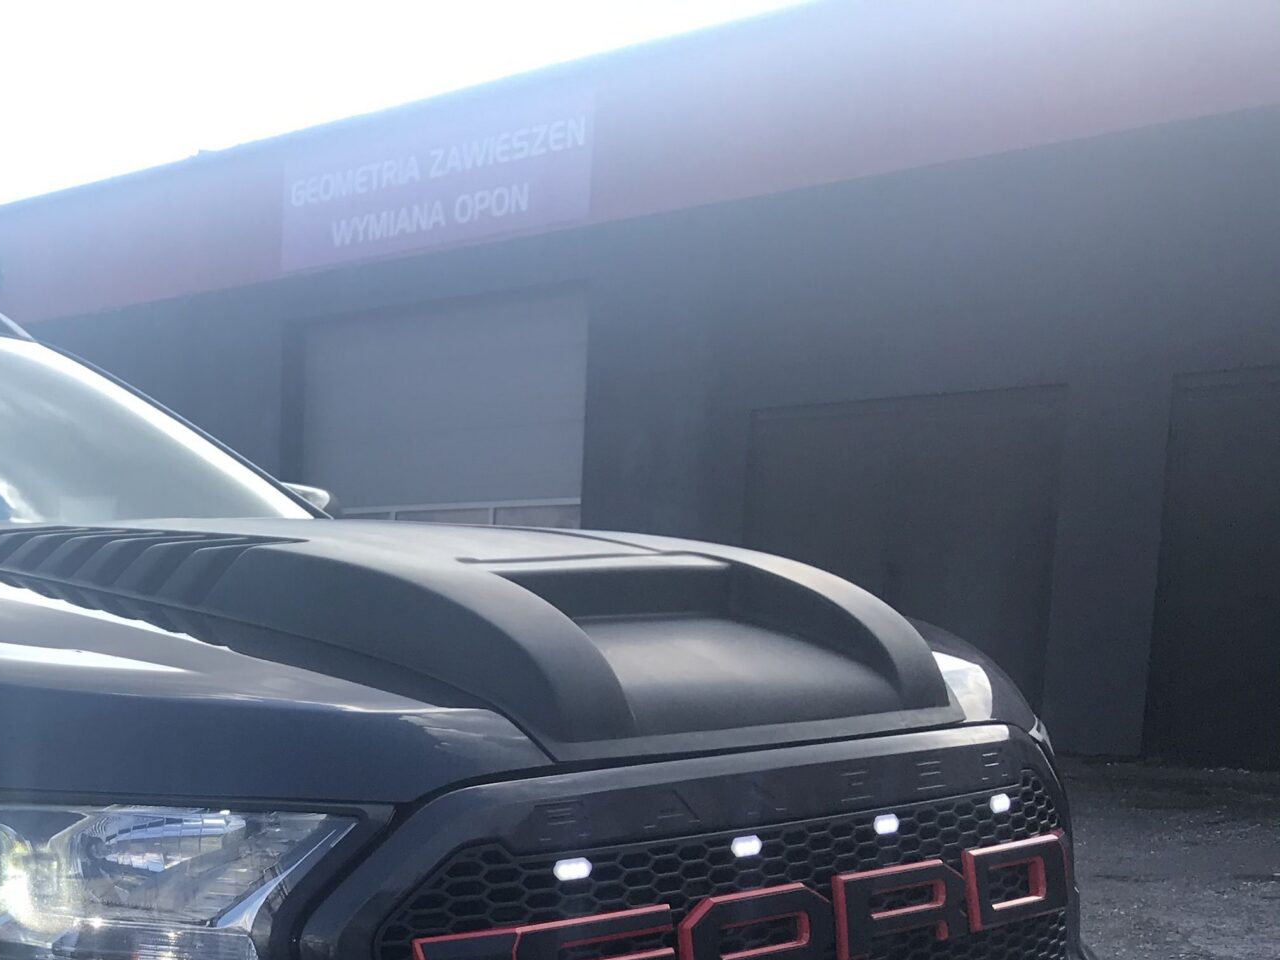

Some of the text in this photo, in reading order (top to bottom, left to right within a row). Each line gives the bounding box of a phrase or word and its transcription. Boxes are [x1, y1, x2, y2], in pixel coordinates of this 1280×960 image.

[291, 155, 421, 207] GEOMETRIA
[332, 183, 529, 248] WYMIANA OPON
